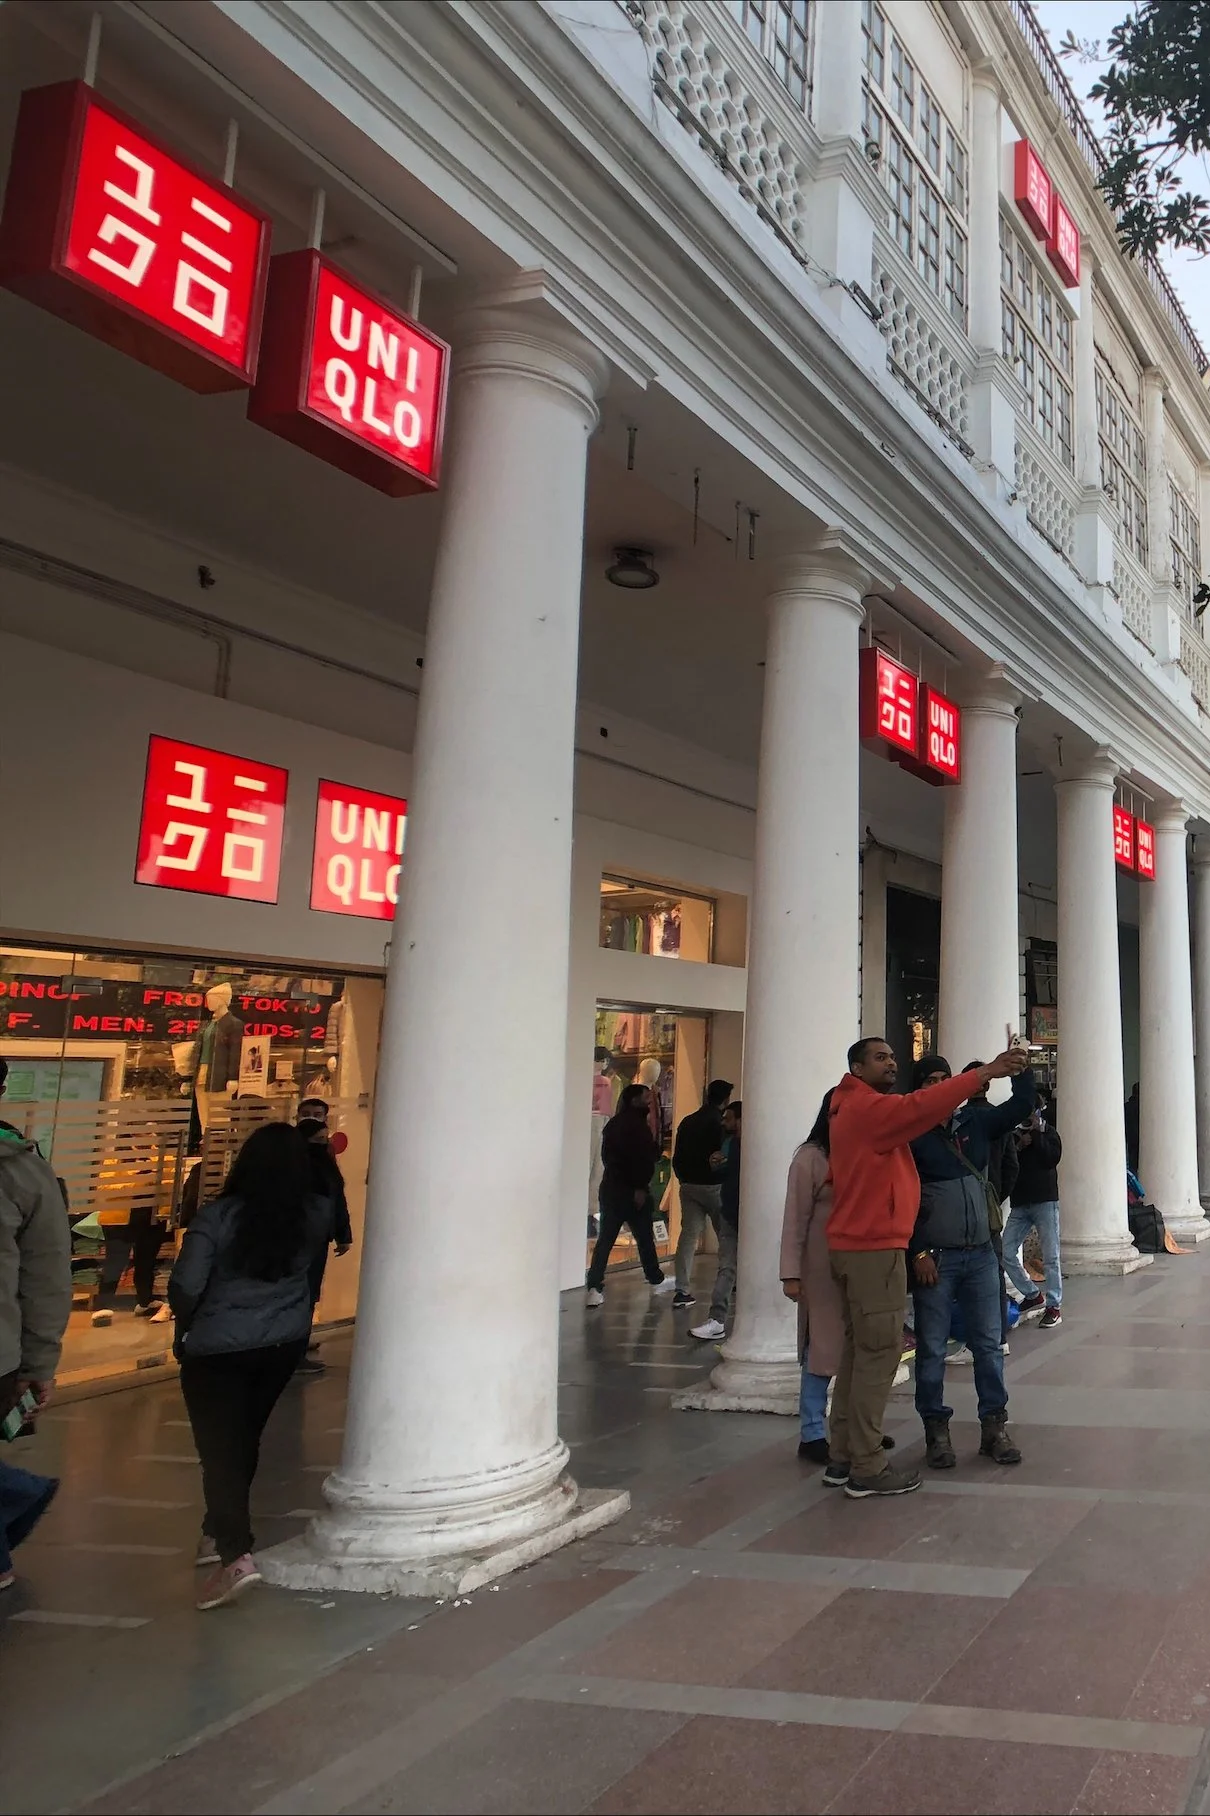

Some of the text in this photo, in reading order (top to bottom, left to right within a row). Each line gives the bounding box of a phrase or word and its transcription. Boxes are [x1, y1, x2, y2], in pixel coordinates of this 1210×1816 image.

[103, 145, 232, 272] ユニ
[330, 294, 419, 392] UNI
[324, 358, 422, 448] QLO
[930, 700, 954, 738] UNI
[930, 731, 956, 767] QLO
[166, 760, 269, 826] ユニ
[331, 799, 408, 855] UNI
[1138, 828, 1152, 851] UNI
[1138, 848, 1153, 870] QLO
[143, 989, 209, 1008] FRO
[238, 996, 321, 1014] TOK
[73, 1015, 154, 1033] MEN:
